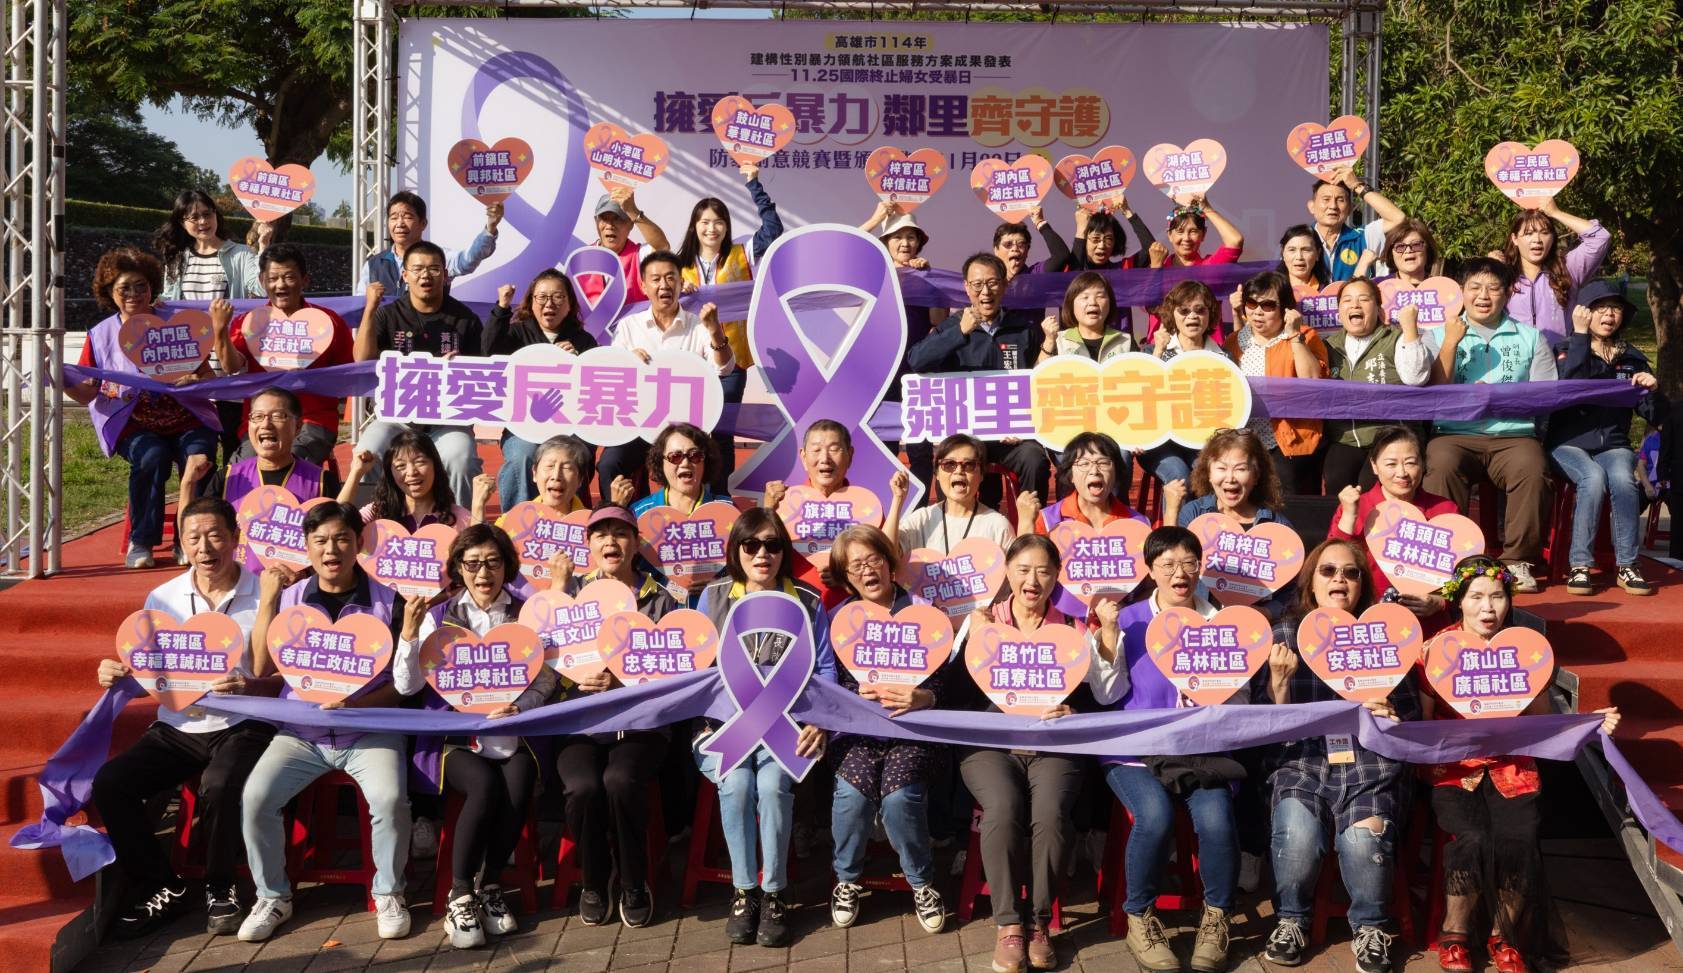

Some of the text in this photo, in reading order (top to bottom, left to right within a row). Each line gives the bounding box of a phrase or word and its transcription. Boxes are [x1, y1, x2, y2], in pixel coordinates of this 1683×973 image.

[835, 35, 927, 49] 高雄市114年
[750, 53, 1012, 68] 建構性別暴力領航社區服務方案成果發表
[791, 68, 971, 84] 11.25國際終止婦女受暴日
[653, 91, 1102, 137] 擁暴力 鄰里齊守護
[736, 111, 772, 130] 鼓山區
[727, 126, 775, 147] 華豐社區
[1311, 130, 1346, 148] 三民區
[473, 152, 510, 166] 前鎮區
[611, 142, 643, 160] 小港區
[1306, 144, 1354, 163] 河堤社區
[592, 152, 655, 178] 山明水秀社區
[889, 161, 926, 176] 梓官區
[1077, 161, 1113, 179] 湖內區
[1515, 155, 1550, 168] 三民區
[256, 171, 289, 187] 前鎮區
[467, 168, 517, 184] 興邦社區
[882, 176, 931, 192] 梓信社區
[994, 169, 1030, 185] 湖內區
[1074, 174, 1122, 195] 逸賢社區
[1497, 168, 1568, 182] 幸福千歲社區
[239, 180, 303, 202] 幸福興東社區
[990, 184, 1038, 201] 湖庄社區
[1302, 296, 1338, 311] 美濃區
[1397, 291, 1437, 306] 杉林區
[148, 326, 190, 344] 內門區
[268, 320, 308, 336] 六龜區
[143, 343, 200, 362] 內門社區
[260, 338, 313, 353] 文武社區
[381, 357, 706, 428] 擁愛反暴力
[907, 367, 1234, 438] 鄰里齊守護
[804, 502, 851, 519] 旗津區
[536, 519, 586, 544] 林園區
[667, 521, 715, 541] 大寮區
[796, 521, 859, 539] 中華社
[1399, 520, 1451, 549] 橋頭區
[388, 538, 435, 559] 大寮區
[659, 541, 724, 561] 義仁社區
[1075, 538, 1125, 557] 大社區
[1219, 532, 1271, 558] 楠梓區
[1385, 540, 1455, 572] 東林社區
[378, 558, 441, 580] 溪寮社區
[926, 555, 975, 580] 甲仙區
[1068, 560, 1134, 579] 保社社區
[1207, 553, 1276, 581] 大昌社區
[923, 575, 987, 601] 甲仙社區
[556, 602, 600, 626] 鳳山區
[157, 632, 204, 650] 苓雅區
[308, 631, 353, 652] 苓雅區
[632, 630, 684, 650] 鳳山區
[866, 624, 918, 645] 路竹區
[1182, 627, 1236, 647] 仁武區
[1334, 623, 1388, 646] 三民區
[132, 652, 227, 672] 幸福意誠社區
[281, 648, 374, 676] 幸福仁政社區
[455, 644, 508, 665] 鳳山區
[625, 653, 694, 673] 忠孝社區
[856, 646, 928, 668] 社南社區
[1001, 645, 1054, 665] 路竹區
[1327, 646, 1399, 671] 安泰社區
[1461, 649, 1518, 671] 旗山區
[438, 666, 528, 688] 新過埤社區
[991, 667, 1064, 689] 頂寮社區
[1455, 672, 1528, 695] 廣福社區
